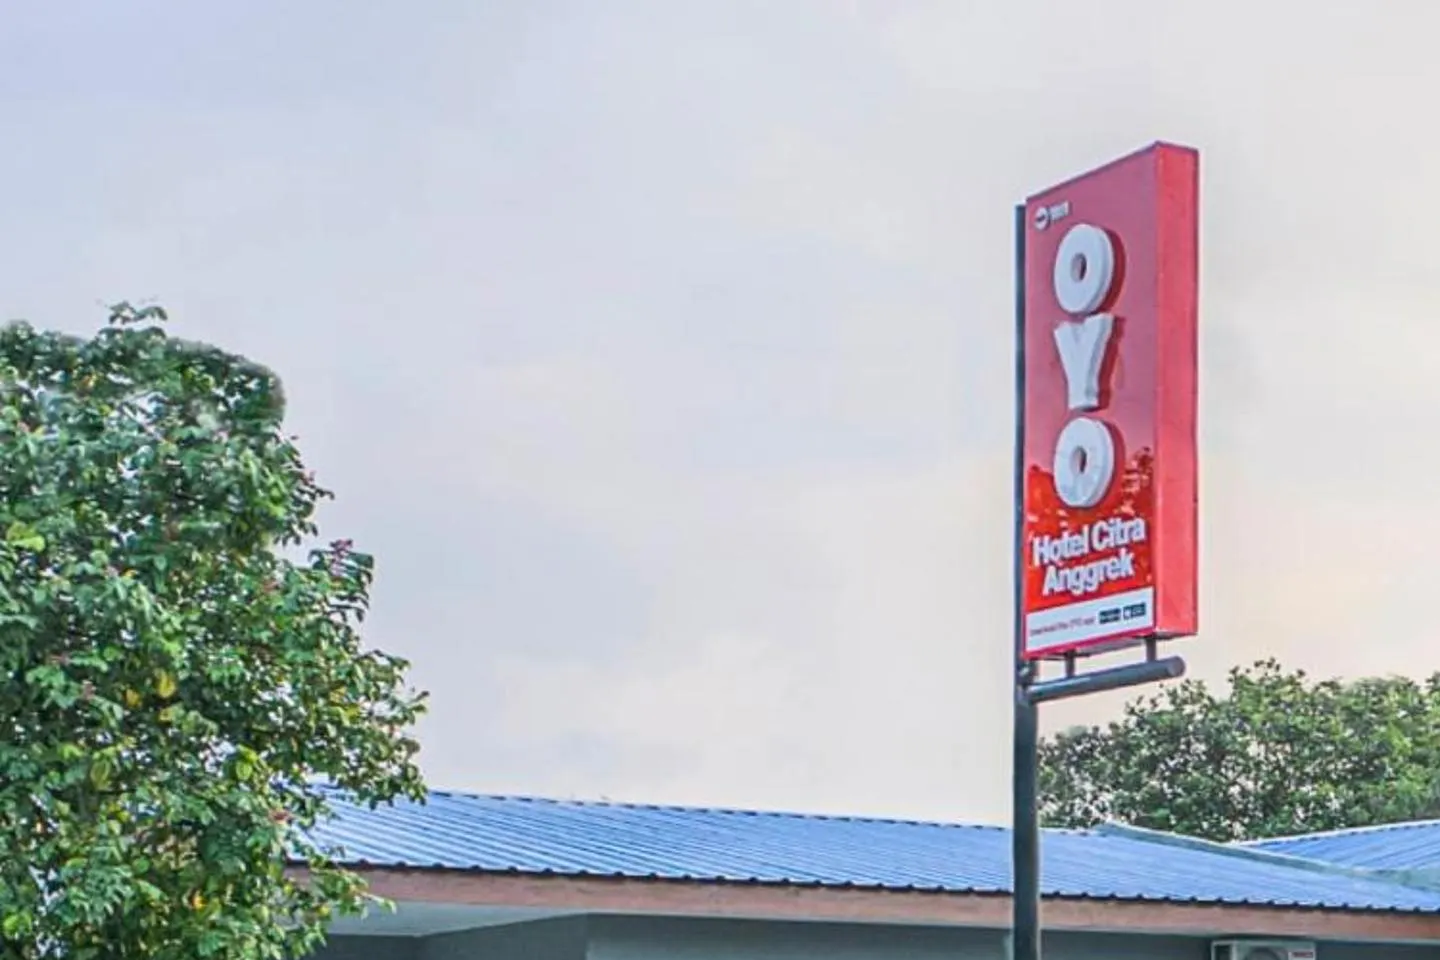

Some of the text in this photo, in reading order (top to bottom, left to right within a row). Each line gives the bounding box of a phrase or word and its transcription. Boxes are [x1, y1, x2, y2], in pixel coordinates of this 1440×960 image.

[1053, 223, 1115, 508] OYO
[1033, 517, 1146, 567] Hotel Citra
[1042, 548, 1134, 596] Anggrek
